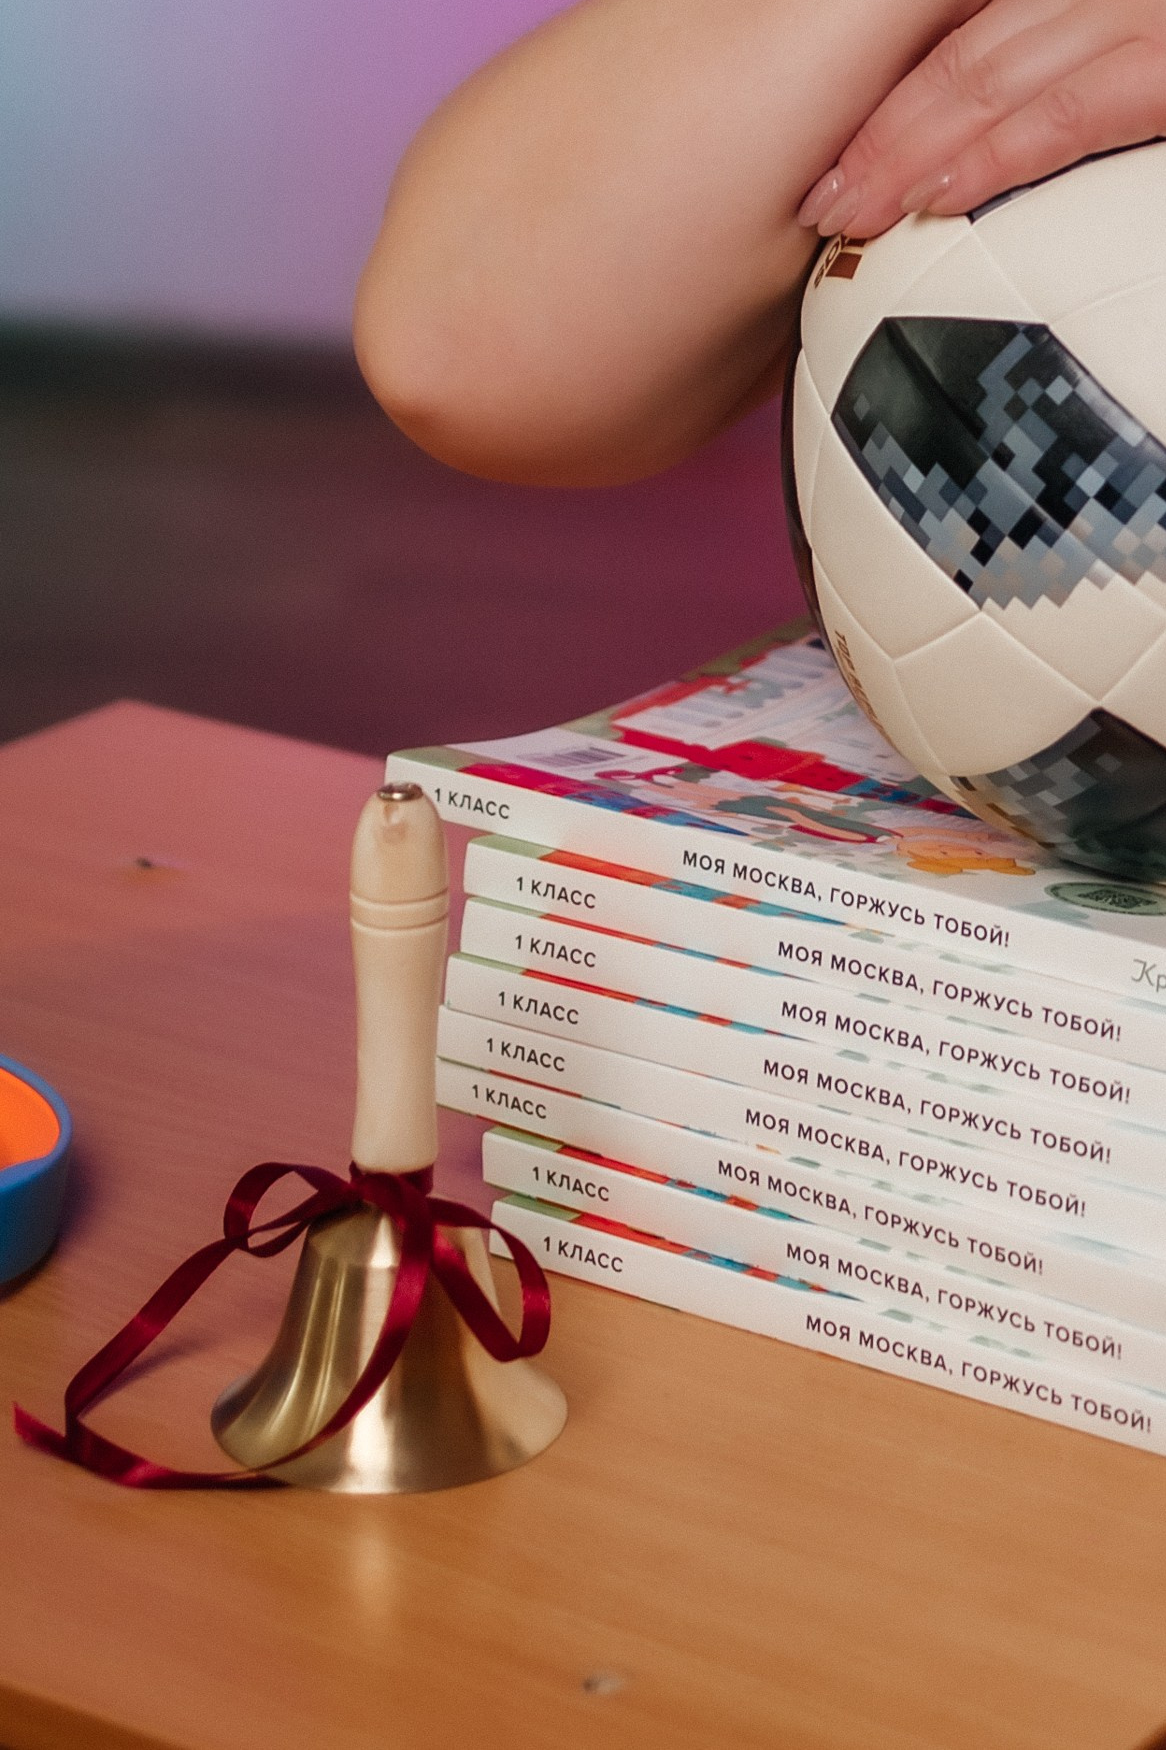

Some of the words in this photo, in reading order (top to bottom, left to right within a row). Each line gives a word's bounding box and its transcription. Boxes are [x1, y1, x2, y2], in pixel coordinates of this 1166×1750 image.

[433, 786, 443, 804] 1
[447, 790, 511, 821] КЛАСС
[514, 874, 525, 893] 1
[530, 878, 597, 910] КЛАСС
[682, 849, 726, 876] МОЯ
[731, 861, 823, 903] МОСКВА,
[829, 886, 926, 927] ГОРЖУСЬ
[932, 912, 1011, 949] ТОБОЙ!
[513, 932, 524, 952] 1
[528, 936, 597, 969] КЛАСС
[496, 989, 507, 1009] 1
[512, 993, 580, 1026] КЛАСС
[777, 940, 824, 968] МОЯ
[829, 953, 925, 996] МОСКВА,
[931, 978, 1034, 1020] ГОРЖУСЬ
[1041, 1005, 1122, 1043] ТОБОЙ!
[485, 1036, 495, 1055] 1
[500, 1040, 566, 1073] КЛАСС
[780, 1000, 828, 1028] МОЯ
[833, 1013, 931, 1057] МОСКВА,
[937, 1039, 1042, 1082] ГОРЖУСЬ
[1048, 1067, 1131, 1105] ТОБОЙ!
[470, 1082, 481, 1101] 1
[485, 1087, 548, 1120] КЛАСС
[762, 1058, 810, 1086] МОЯ
[815, 1071, 912, 1115] МОСКВА,
[919, 1098, 1023, 1141] ГОРЖУСЬ
[1029, 1127, 1112, 1165] ТОБОЙ!
[530, 1164, 541, 1183] 1
[545, 1169, 610, 1203] КЛАСС
[744, 1107, 791, 1136] МОЯ
[796, 1121, 891, 1166] МОСКВА,
[898, 1149, 999, 1194] ГОРЖУСЬ
[1005, 1179, 1087, 1218] ТОБОЙ!
[717, 1159, 761, 1187] МОЯ
[766, 1174, 858, 1220] МОСКВА,
[863, 1204, 961, 1250] ГОРЖУСЬ
[966, 1236, 1044, 1276] ТОБОЙ!
[542, 1234, 552, 1254] 1
[557, 1239, 624, 1274] КЛАСС
[786, 1242, 831, 1271] МОЯ
[836, 1257, 931, 1304] МОСКВА,
[937, 1287, 1037, 1334] ГОРЖУСЬ
[1042, 1320, 1123, 1361] ТОБОЙ!
[805, 1313, 852, 1343] МОЯ
[858, 1329, 954, 1376] МОСКВА,
[960, 1360, 1064, 1407] ГОРЖУСЬ
[1070, 1393, 1152, 1434] ТОБОЙ!
